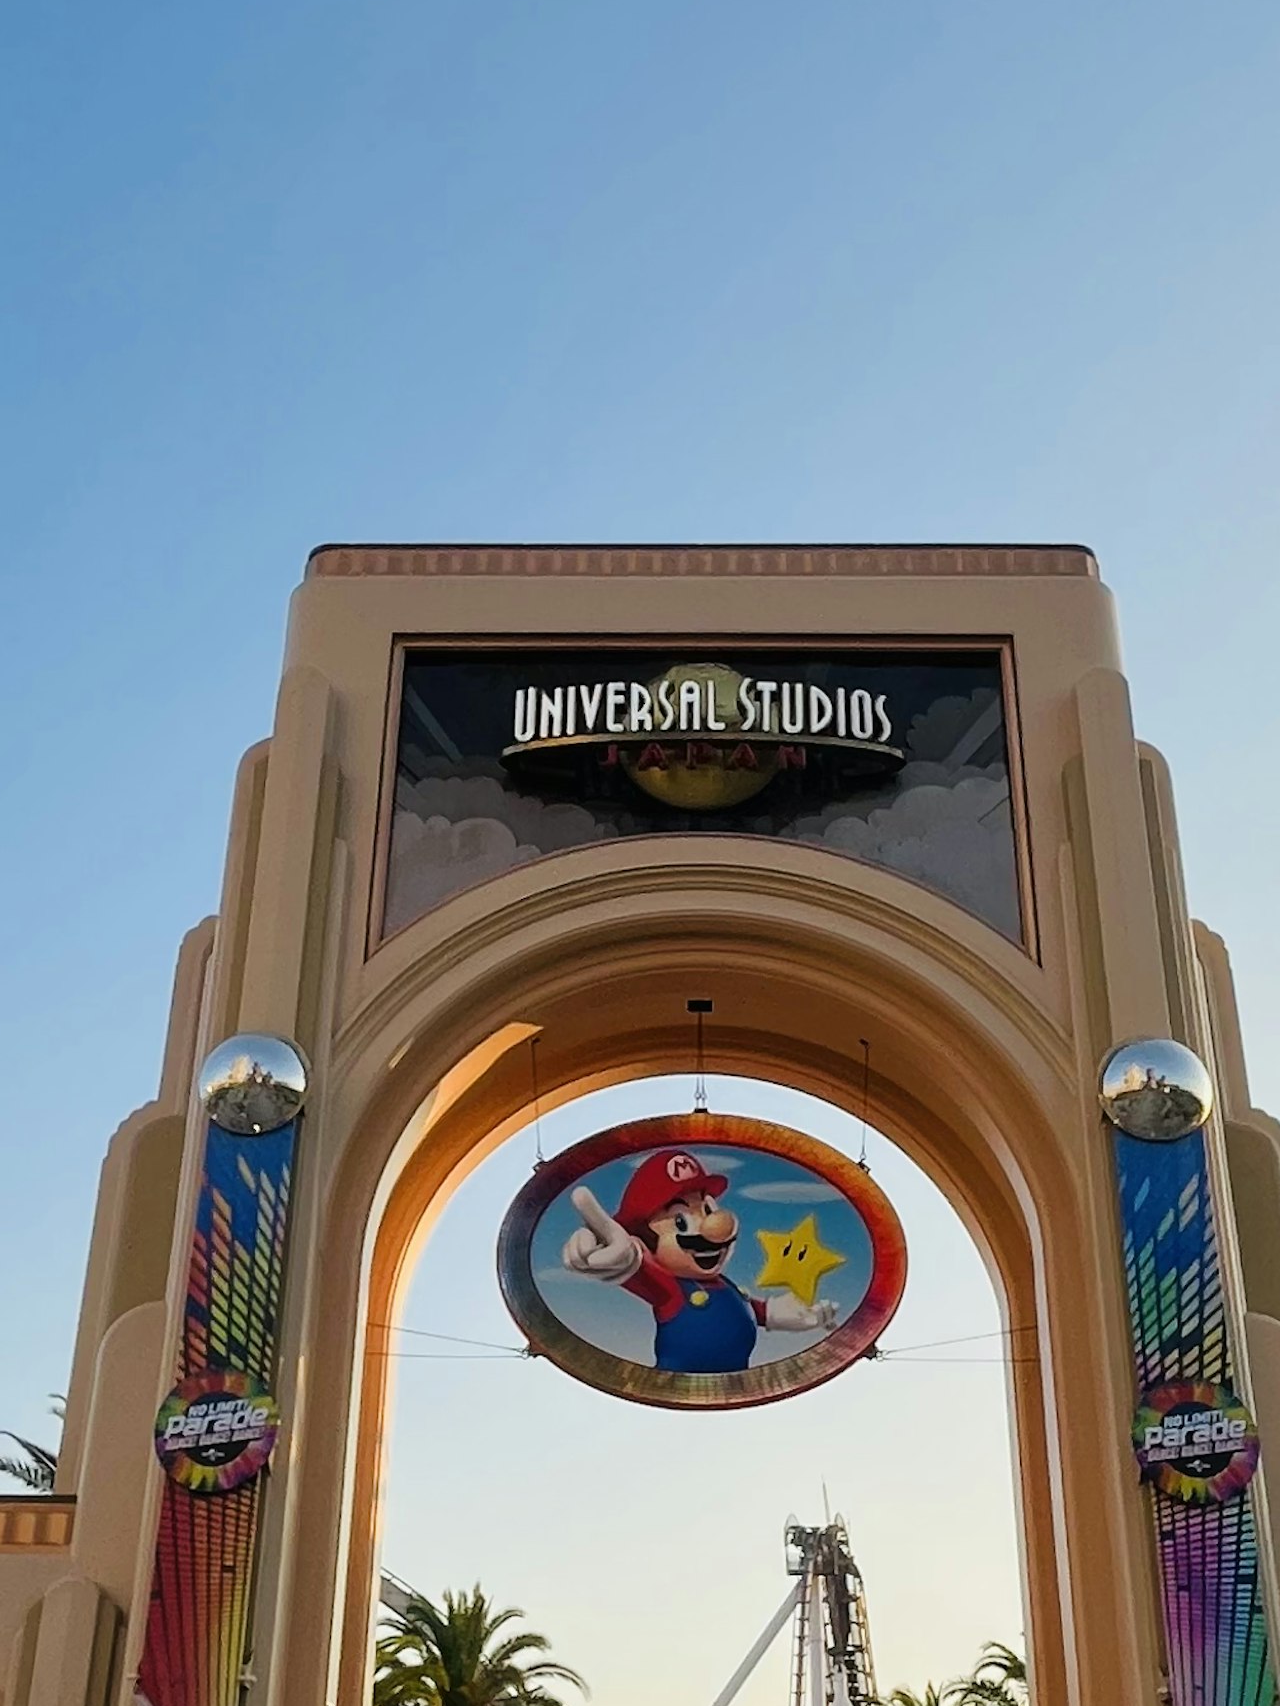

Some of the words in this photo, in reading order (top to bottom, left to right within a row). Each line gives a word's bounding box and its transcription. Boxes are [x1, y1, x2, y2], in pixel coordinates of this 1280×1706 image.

[514, 679, 725, 743] UNIVERSAL
[739, 677, 892, 743] STUDIOS
[599, 742, 807, 771] JAPAN
